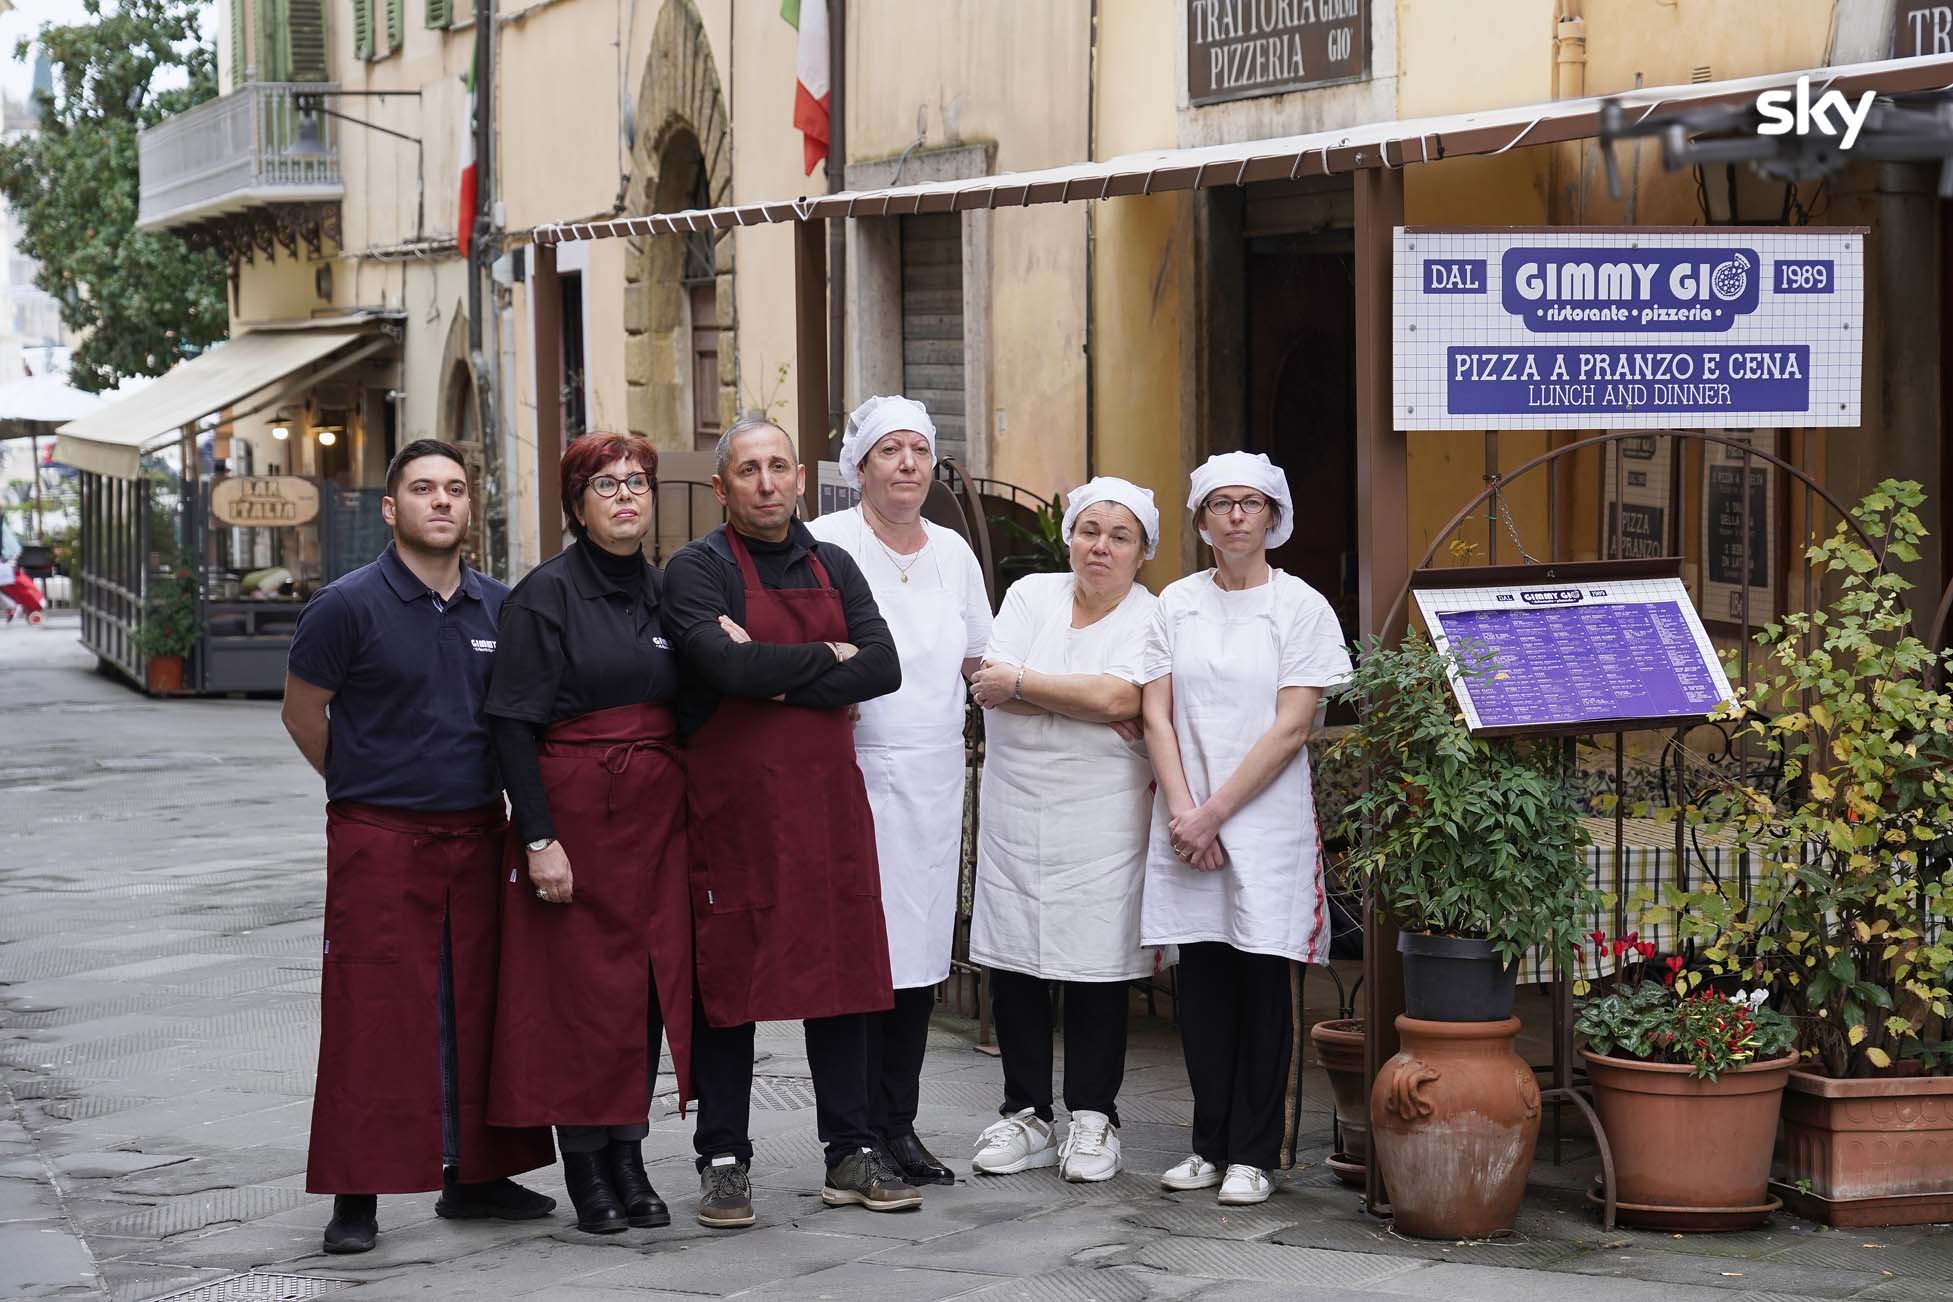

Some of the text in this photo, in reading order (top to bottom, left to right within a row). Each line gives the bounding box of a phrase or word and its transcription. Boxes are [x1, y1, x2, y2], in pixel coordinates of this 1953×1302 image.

[1210, 33, 1305, 89] PIZZERIA
[1431, 265, 1479, 289] DAL
[1515, 262, 1660, 301] GIMMY
[1781, 265, 1827, 289] 1989
[1547, 304, 1712, 325] ristorante pizzeria
[1455, 353, 1802, 380] PIZZA A PRANZO E CENA
[1528, 383, 1732, 406] LUNCH AND DINNER
[229, 501, 296, 520] ITALIA
[1621, 512, 1650, 534] PIZZA
[1524, 592, 1559, 600] GIMMY
